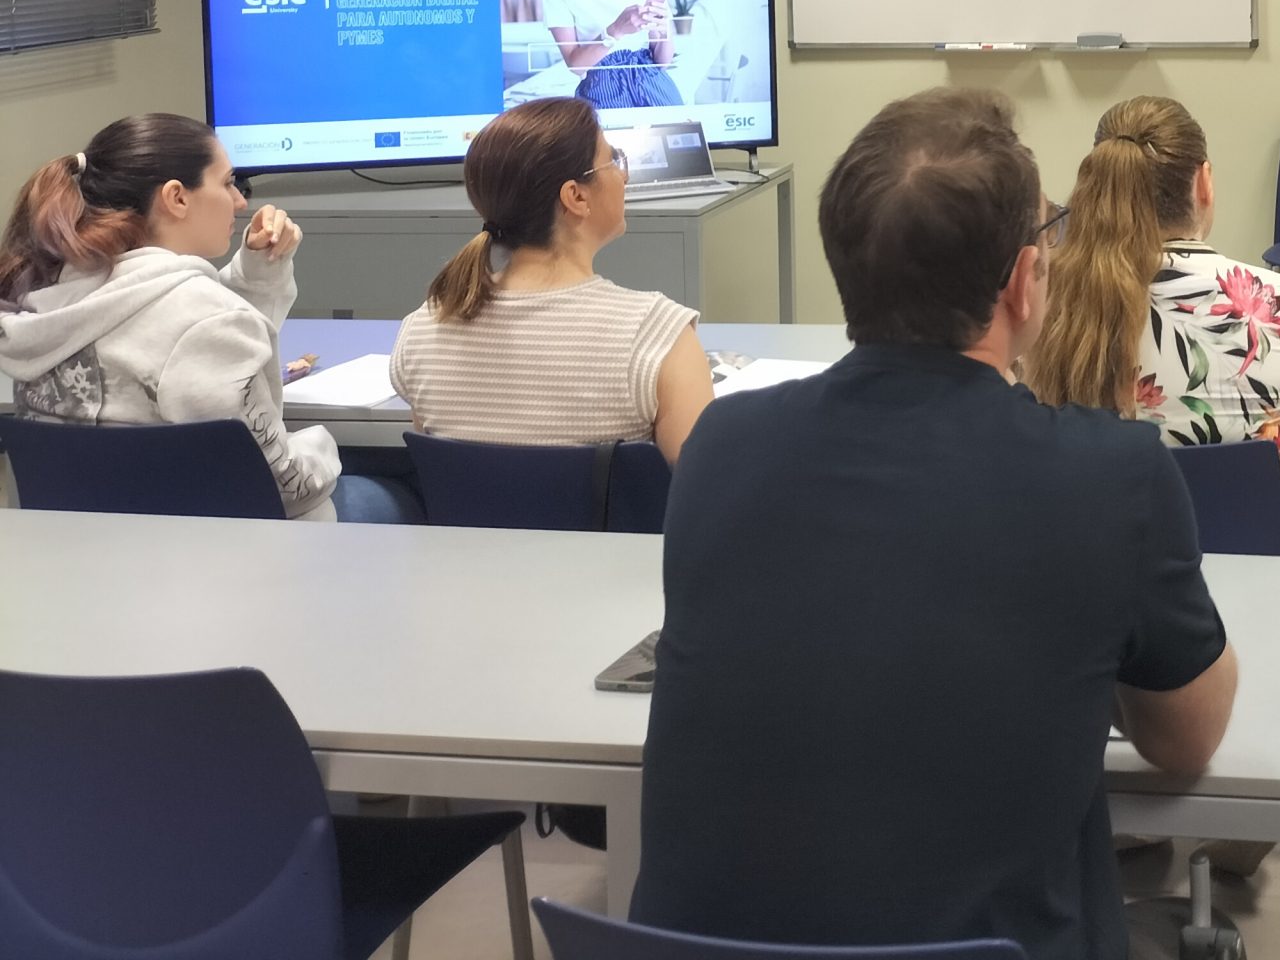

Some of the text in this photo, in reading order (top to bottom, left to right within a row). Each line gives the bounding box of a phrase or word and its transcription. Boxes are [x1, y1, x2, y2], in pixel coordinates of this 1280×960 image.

[336, 11, 375, 28] PARA
[466, 8, 476, 24] Y
[337, 29, 385, 47] PYMES
